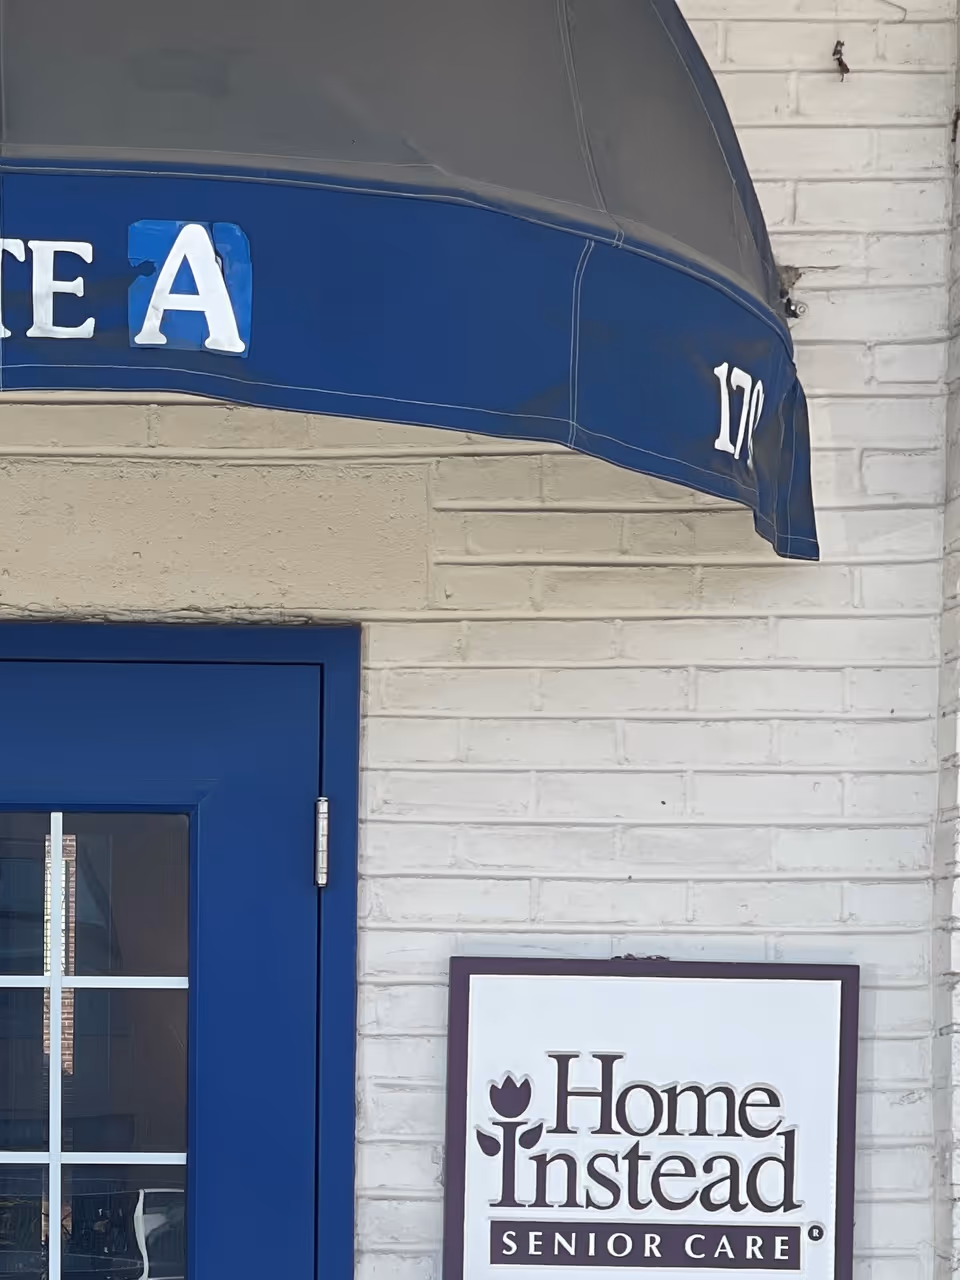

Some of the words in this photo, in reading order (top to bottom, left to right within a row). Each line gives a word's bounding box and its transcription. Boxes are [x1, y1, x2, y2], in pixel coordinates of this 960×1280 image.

[133, 222, 246, 354] A
[547, 1052, 783, 1138] Home
[489, 1121, 803, 1213] Instead
[502, 1230, 662, 1258] SENIOR
[684, 1233, 789, 1260] CARE
